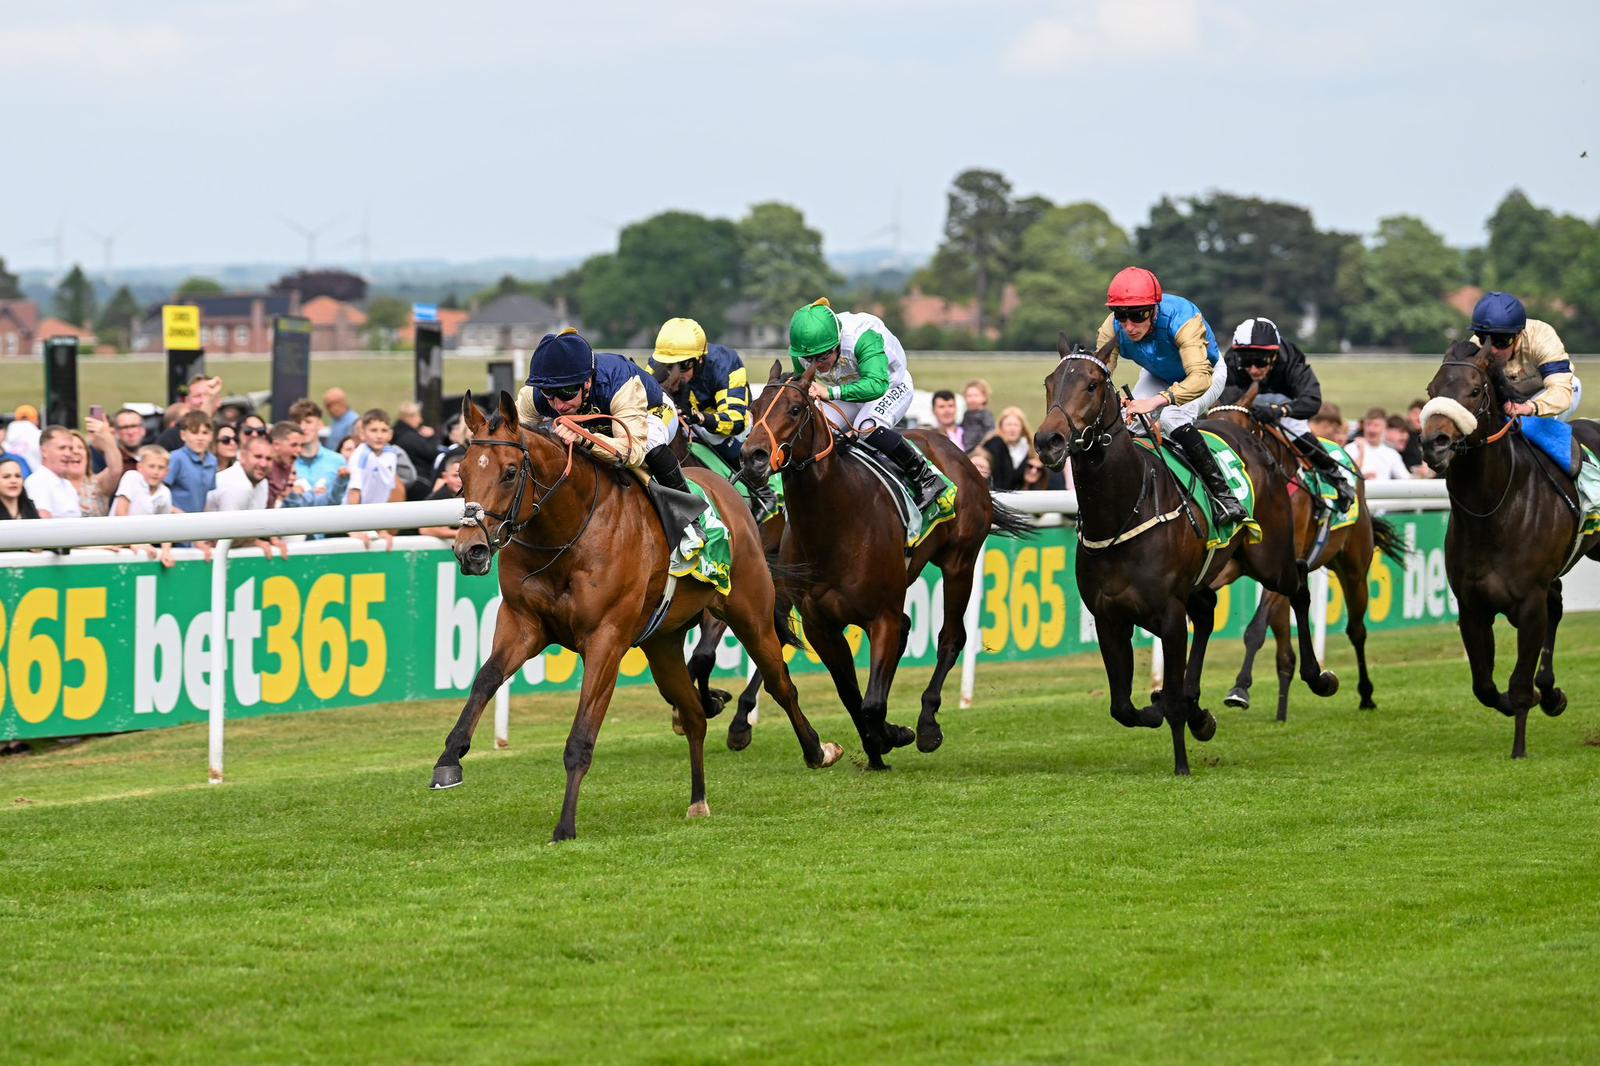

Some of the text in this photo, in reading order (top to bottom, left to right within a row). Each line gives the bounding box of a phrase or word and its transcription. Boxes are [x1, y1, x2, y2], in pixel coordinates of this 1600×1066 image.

[874, 382, 909, 415] BRENBAR
[0, 587, 108, 723] 65
[134, 573, 387, 714] bet365
